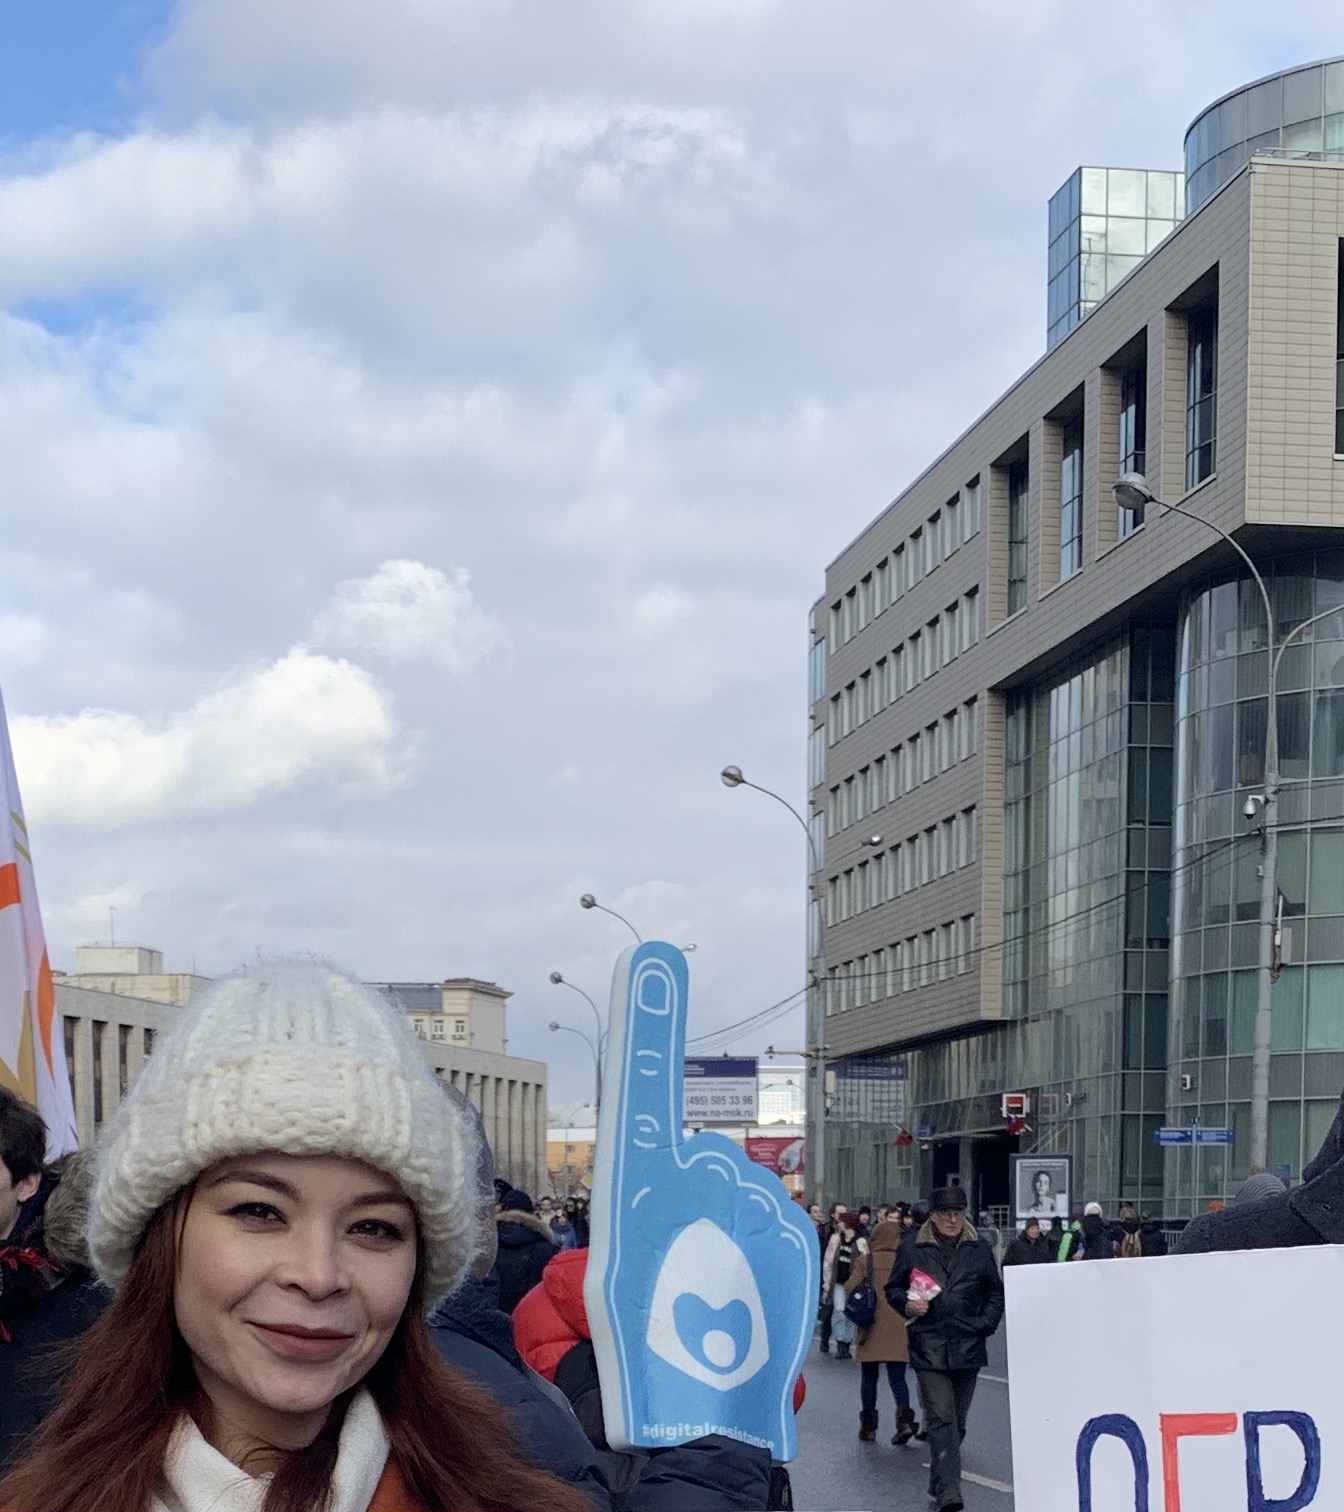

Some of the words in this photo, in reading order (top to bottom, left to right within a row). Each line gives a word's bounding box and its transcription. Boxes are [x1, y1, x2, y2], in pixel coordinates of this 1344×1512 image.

[686, 1096, 709, 1107] (495)
[710, 1096, 727, 1106] 505
[728, 1096, 741, 1106] 33
[687, 1108, 754, 1118] www.na-msk.ru
[641, 1420, 775, 1450] #digitalresistance
